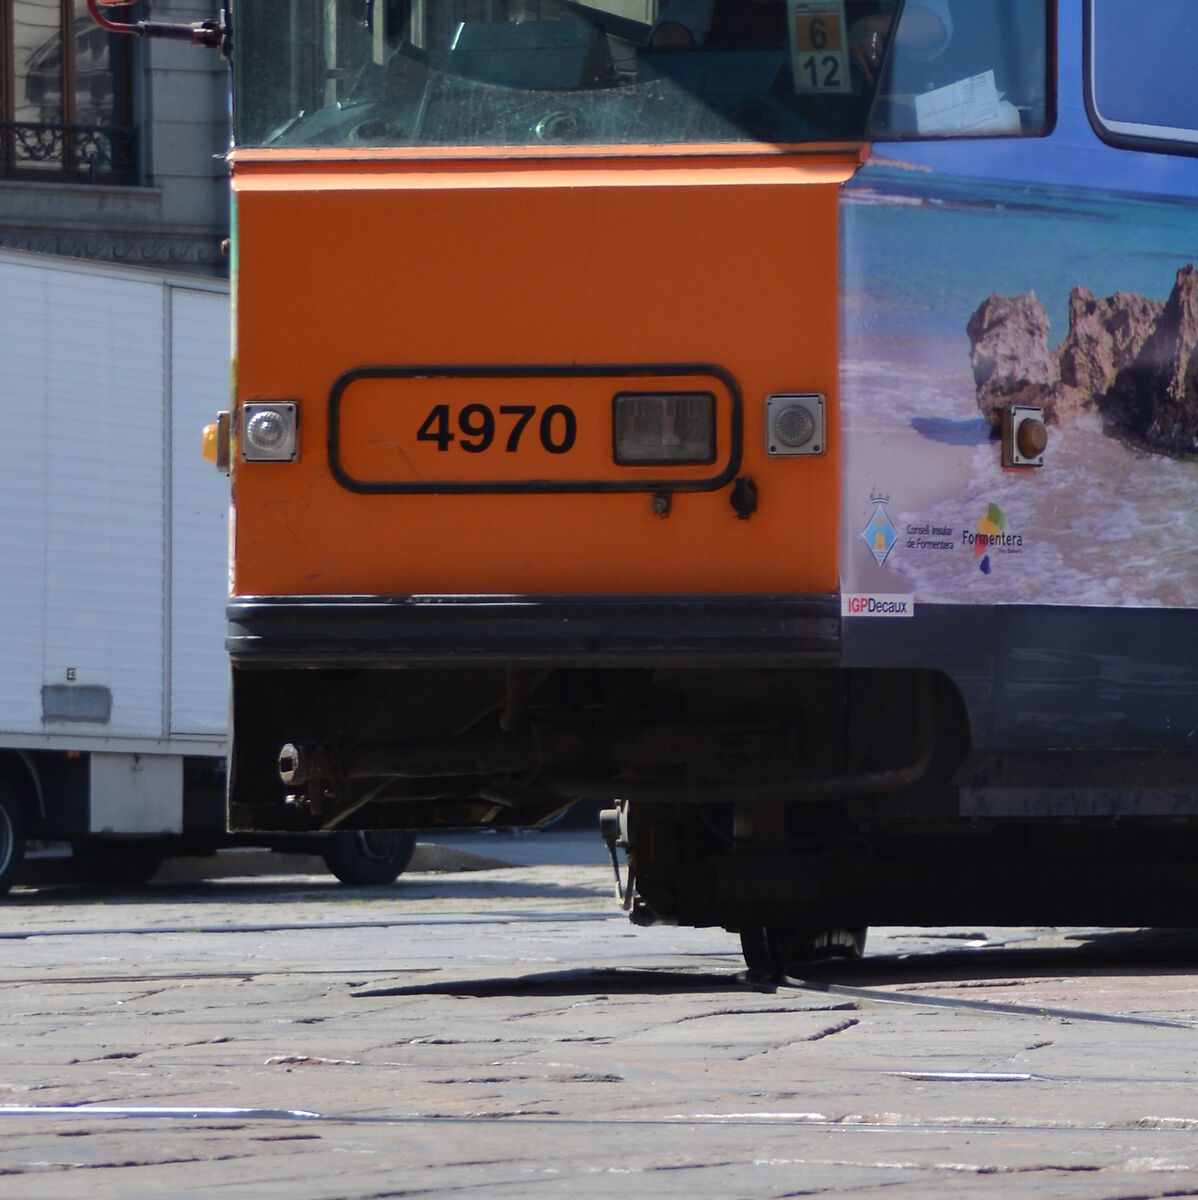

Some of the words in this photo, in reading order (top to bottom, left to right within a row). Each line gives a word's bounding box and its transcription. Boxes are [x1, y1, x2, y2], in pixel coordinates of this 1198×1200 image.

[809, 17, 828, 50] 6
[803, 55, 841, 87] 12
[416, 403, 577, 454] 4970
[906, 524, 930, 536] Consell
[932, 525, 953, 537] Insular
[962, 530, 1023, 546] Formentera
[906, 537, 915, 549] de
[917, 538, 954, 550] Formentera
[848, 598, 907, 613] IGPDecaux
